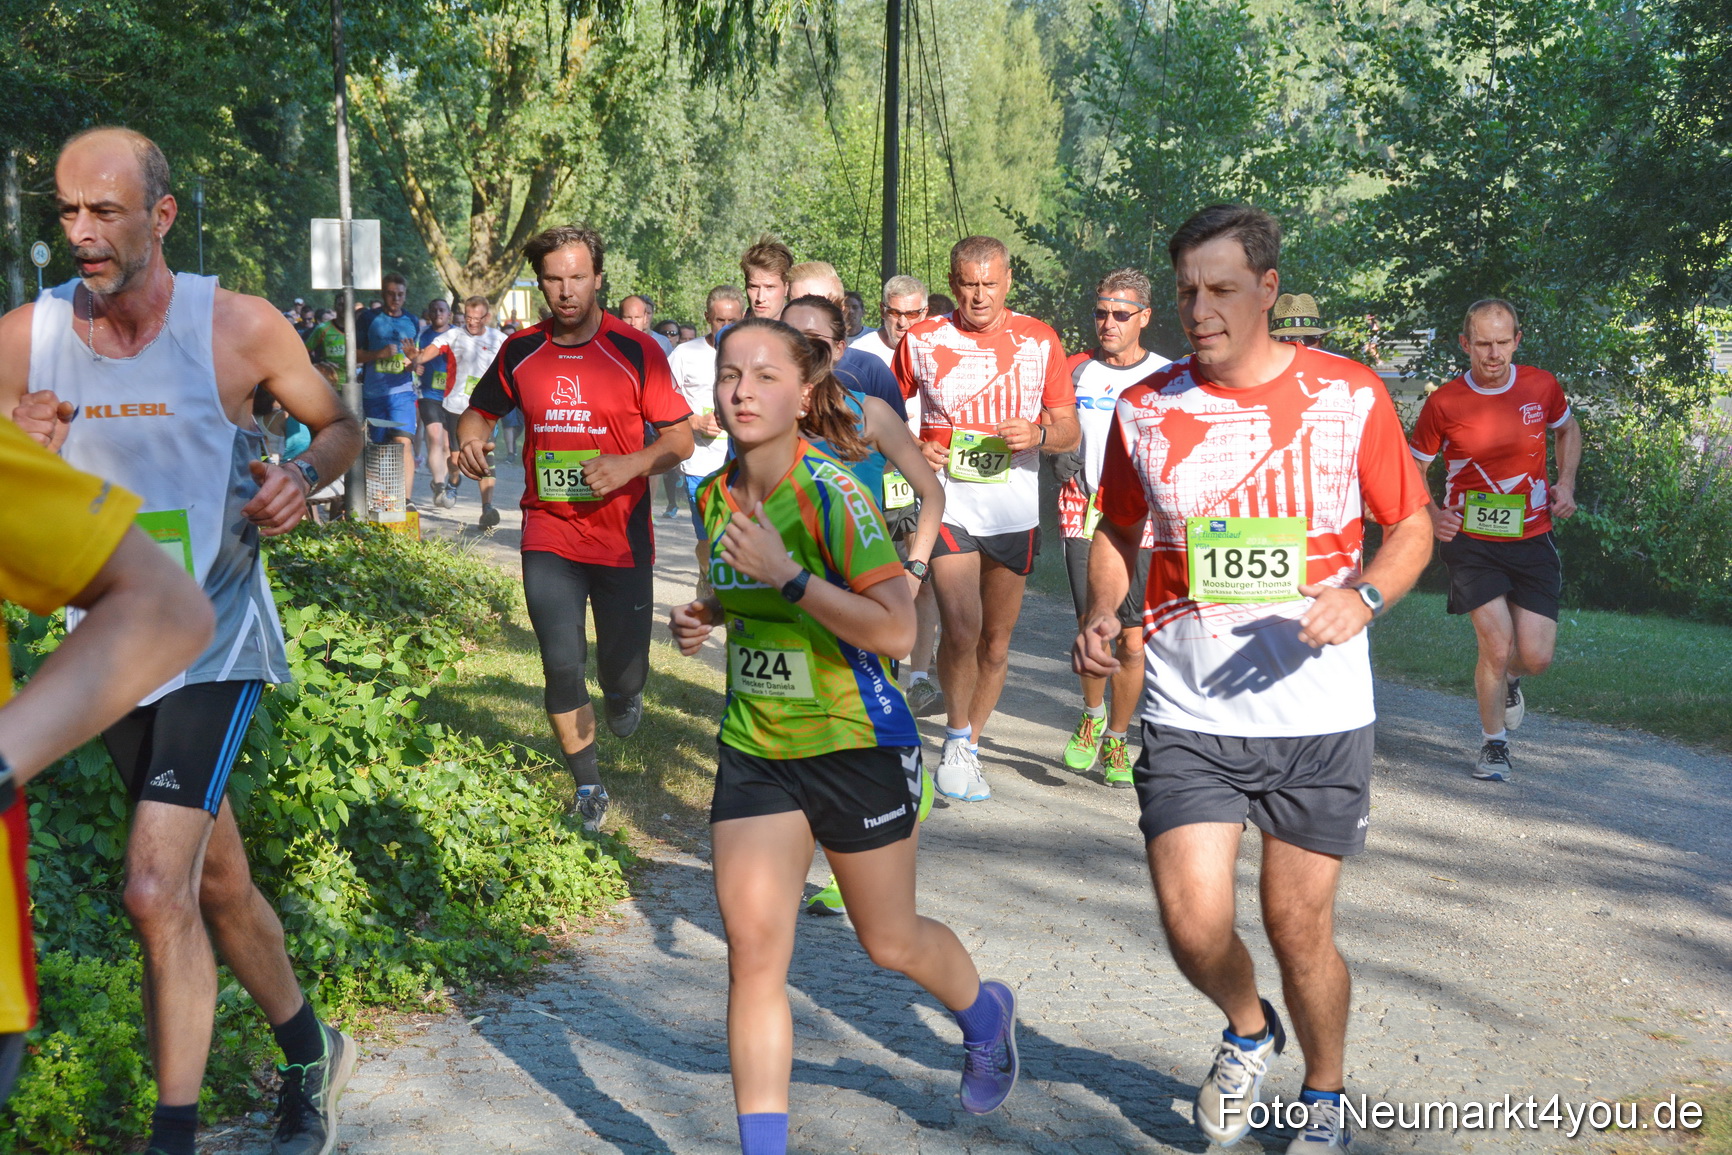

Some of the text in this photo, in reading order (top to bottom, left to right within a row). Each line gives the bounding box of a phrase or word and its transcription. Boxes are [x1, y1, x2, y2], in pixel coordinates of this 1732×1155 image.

[85, 403, 175, 419] KLEBL
[545, 409, 592, 422] MEYER
[587, 426, 607, 435] GmbH
[957, 449, 1005, 471] 1837
[811, 461, 884, 549] BOCK
[1476, 507, 1511, 524] 542
[1202, 531, 1242, 539] firmenlauf
[1203, 548, 1289, 578] 1853
[1202, 580, 1253, 590] Moosburger
[739, 647, 792, 681] 224
[742, 678, 795, 690] Hecker Daniela
[863, 803, 906, 829] hummel
